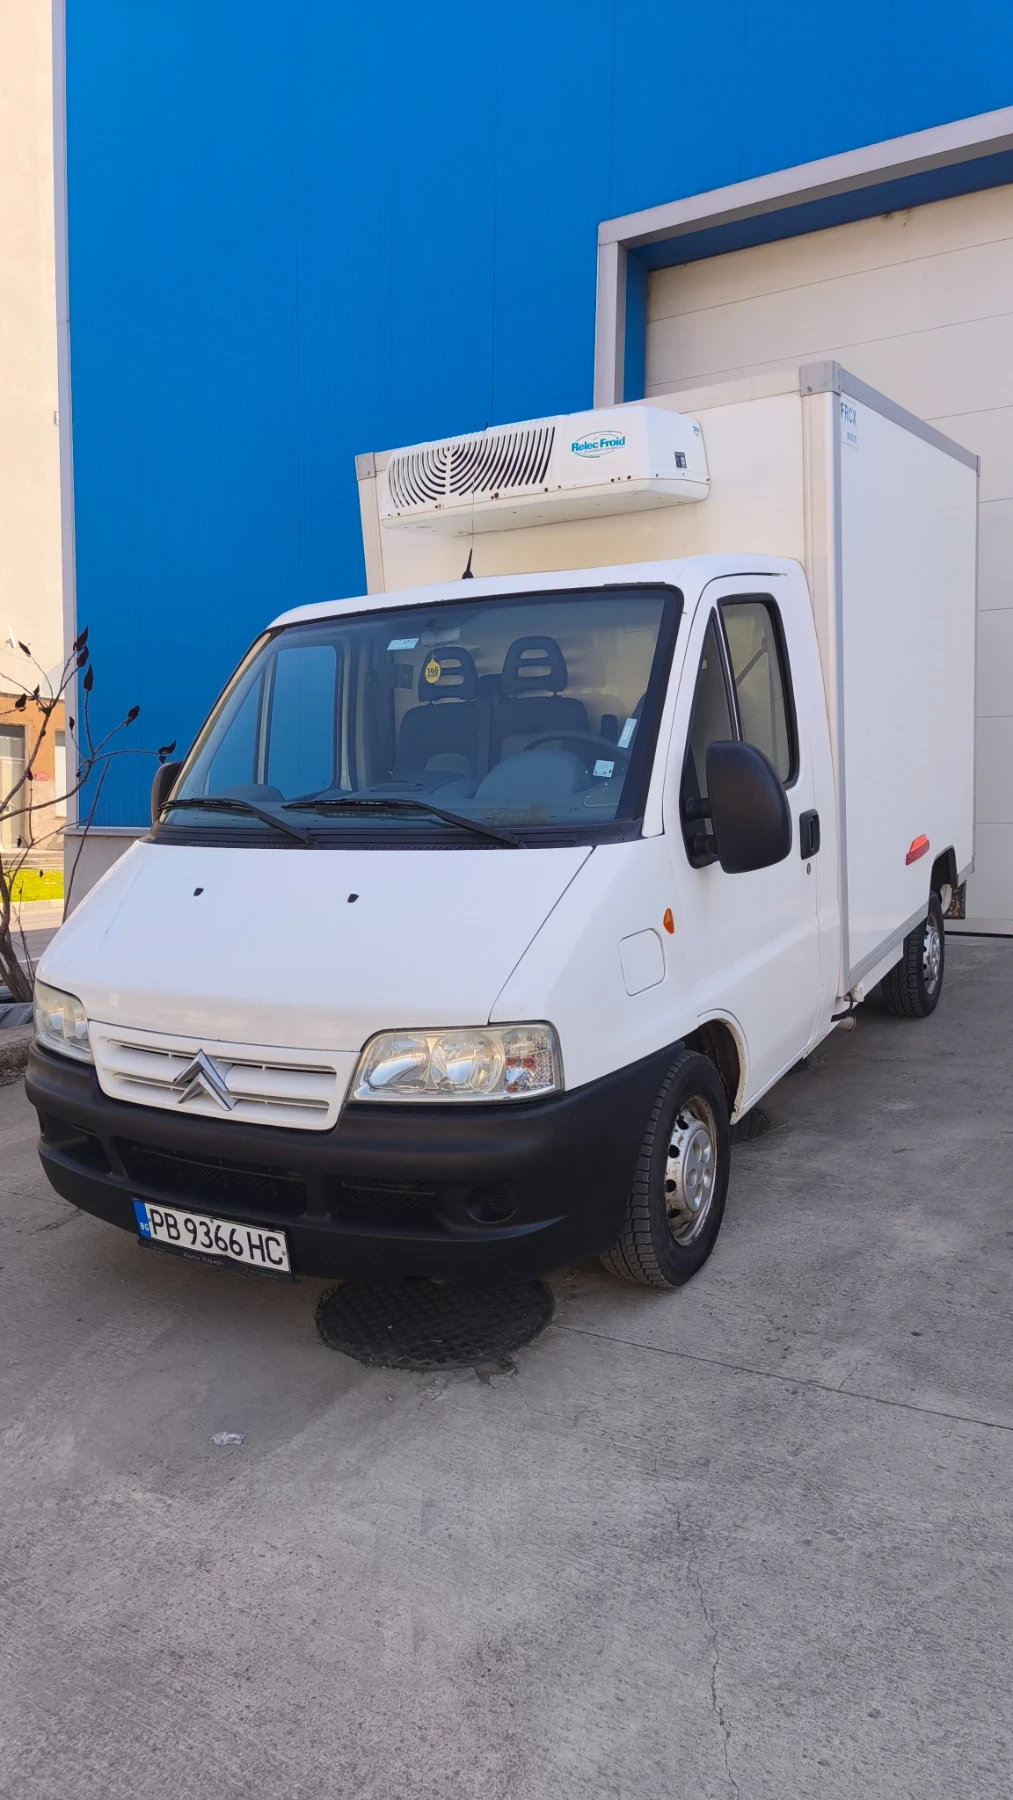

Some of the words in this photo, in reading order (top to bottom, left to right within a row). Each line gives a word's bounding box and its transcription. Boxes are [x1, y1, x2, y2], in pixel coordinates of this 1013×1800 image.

[840, 402, 857, 426] FRCX
[571, 441, 599, 452] Relec
[599, 436, 626, 448] Froid
[139, 1221, 150, 1232] BG
[149, 1208, 181, 1241] PB
[184, 1217, 244, 1257] 9366
[247, 1231, 284, 1266] HC
